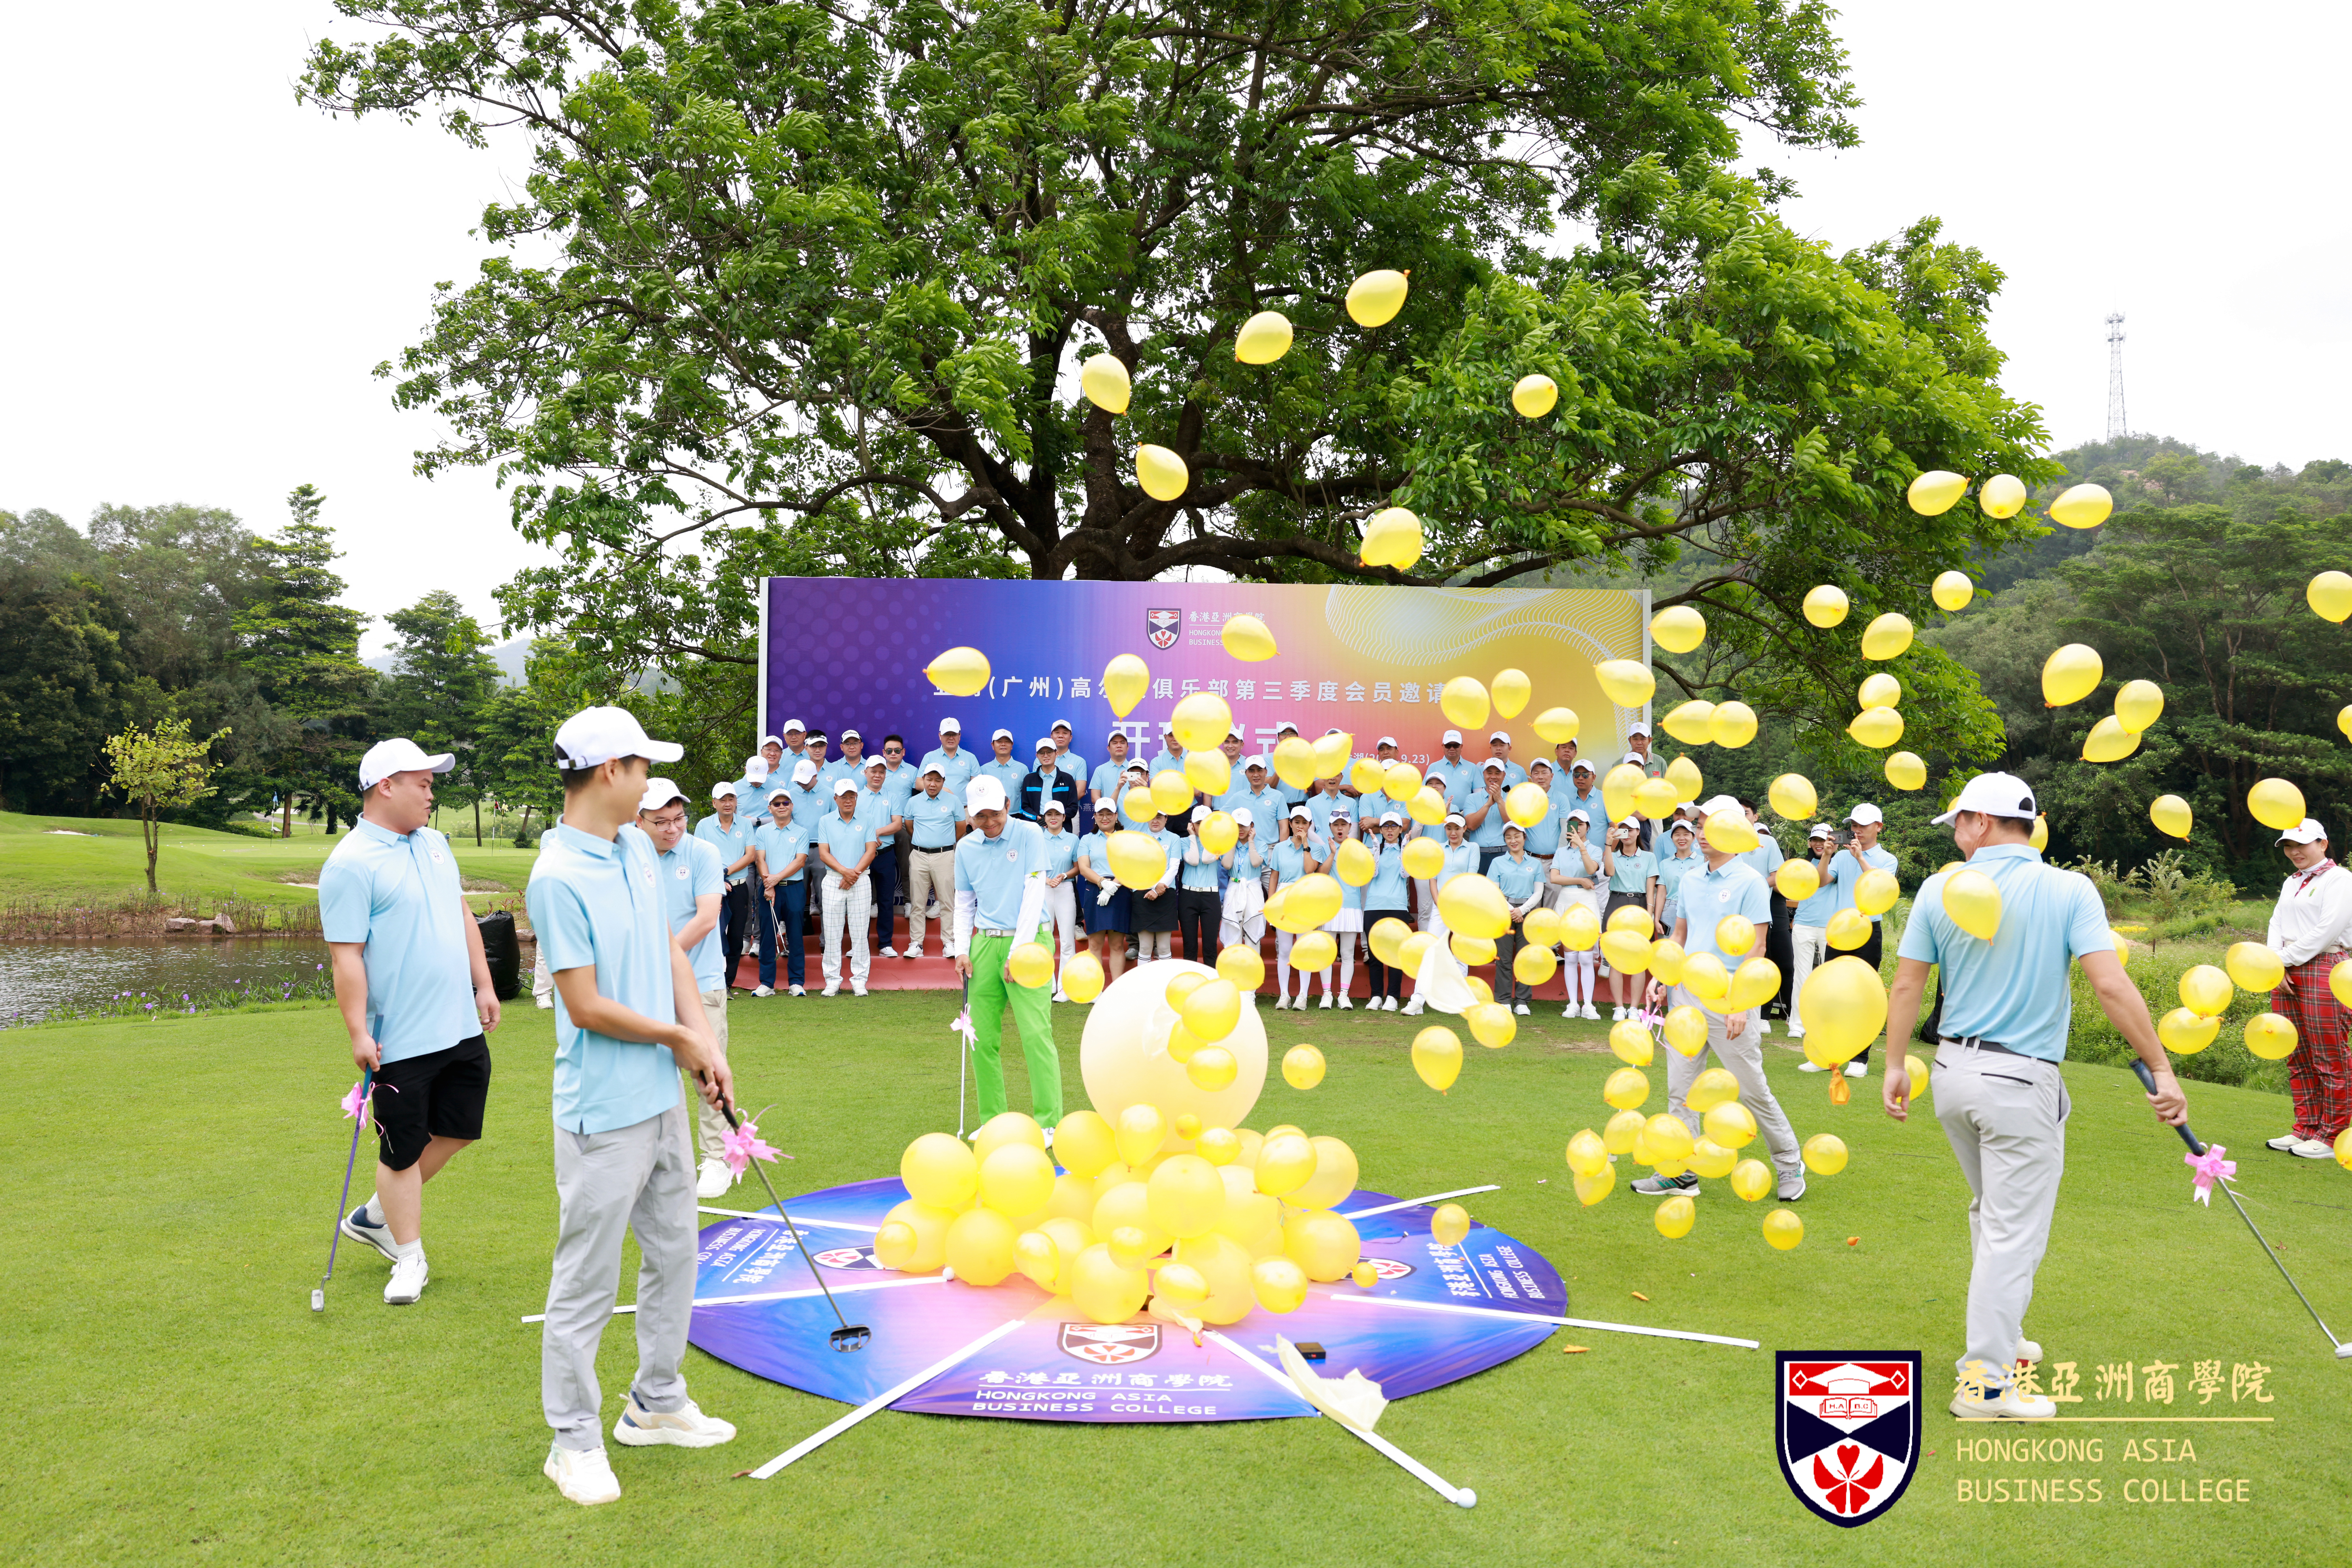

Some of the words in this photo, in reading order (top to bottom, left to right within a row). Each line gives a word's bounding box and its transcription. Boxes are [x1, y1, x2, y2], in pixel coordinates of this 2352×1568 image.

[1189, 611, 1265, 623] 香港亞洲院
[705, 1227, 743, 1251] BUSINESS
[728, 1229, 766, 1252] HONGKONG
[710, 1252, 737, 1267] ASIA
[1479, 1254, 1500, 1268] ASIA
[1496, 1245, 1523, 1268] COLLEGE
[1487, 1270, 1519, 1298] HONGKONG
[1513, 1271, 1545, 1298] BUSINESS
[978, 1370, 1234, 1387] 香港亞洲商學院
[976, 1390, 1096, 1401] HONGKONG
[1111, 1393, 1172, 1402] ASIA
[972, 1402, 1094, 1412] BUSINESS
[1110, 1404, 1216, 1415] COLLEGE
